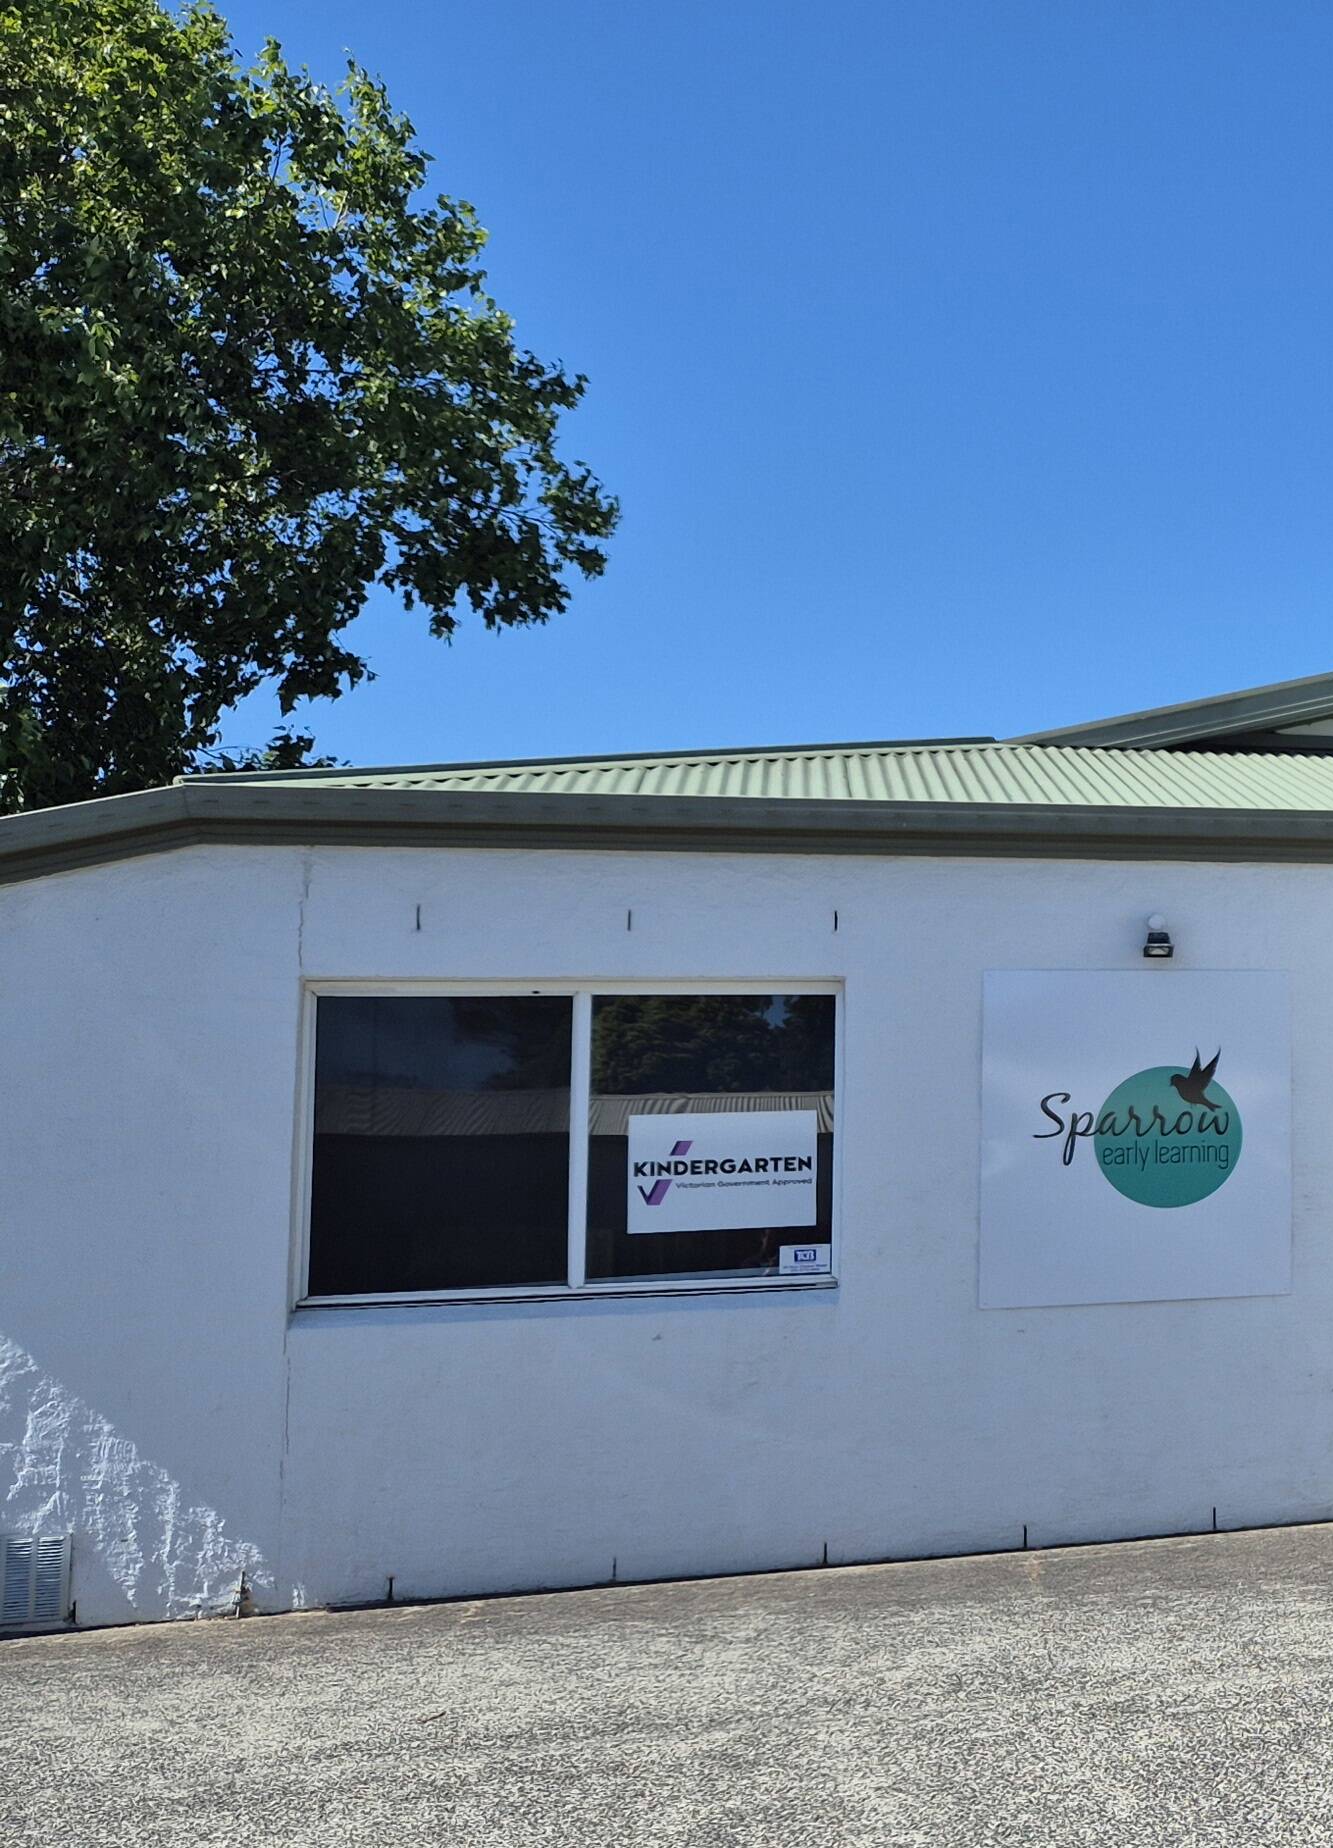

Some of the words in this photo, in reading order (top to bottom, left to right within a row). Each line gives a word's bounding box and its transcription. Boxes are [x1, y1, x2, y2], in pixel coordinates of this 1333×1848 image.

[1032, 1092, 1230, 1167] Sparrow
[633, 1156, 812, 1177] KINDERGARTEN
[1103, 1140, 1150, 1172] early
[1155, 1139, 1229, 1171] learning
[675, 1181, 715, 1189] Victorian
[717, 1179, 770, 1188] Government
[772, 1178, 812, 1186] Approved
